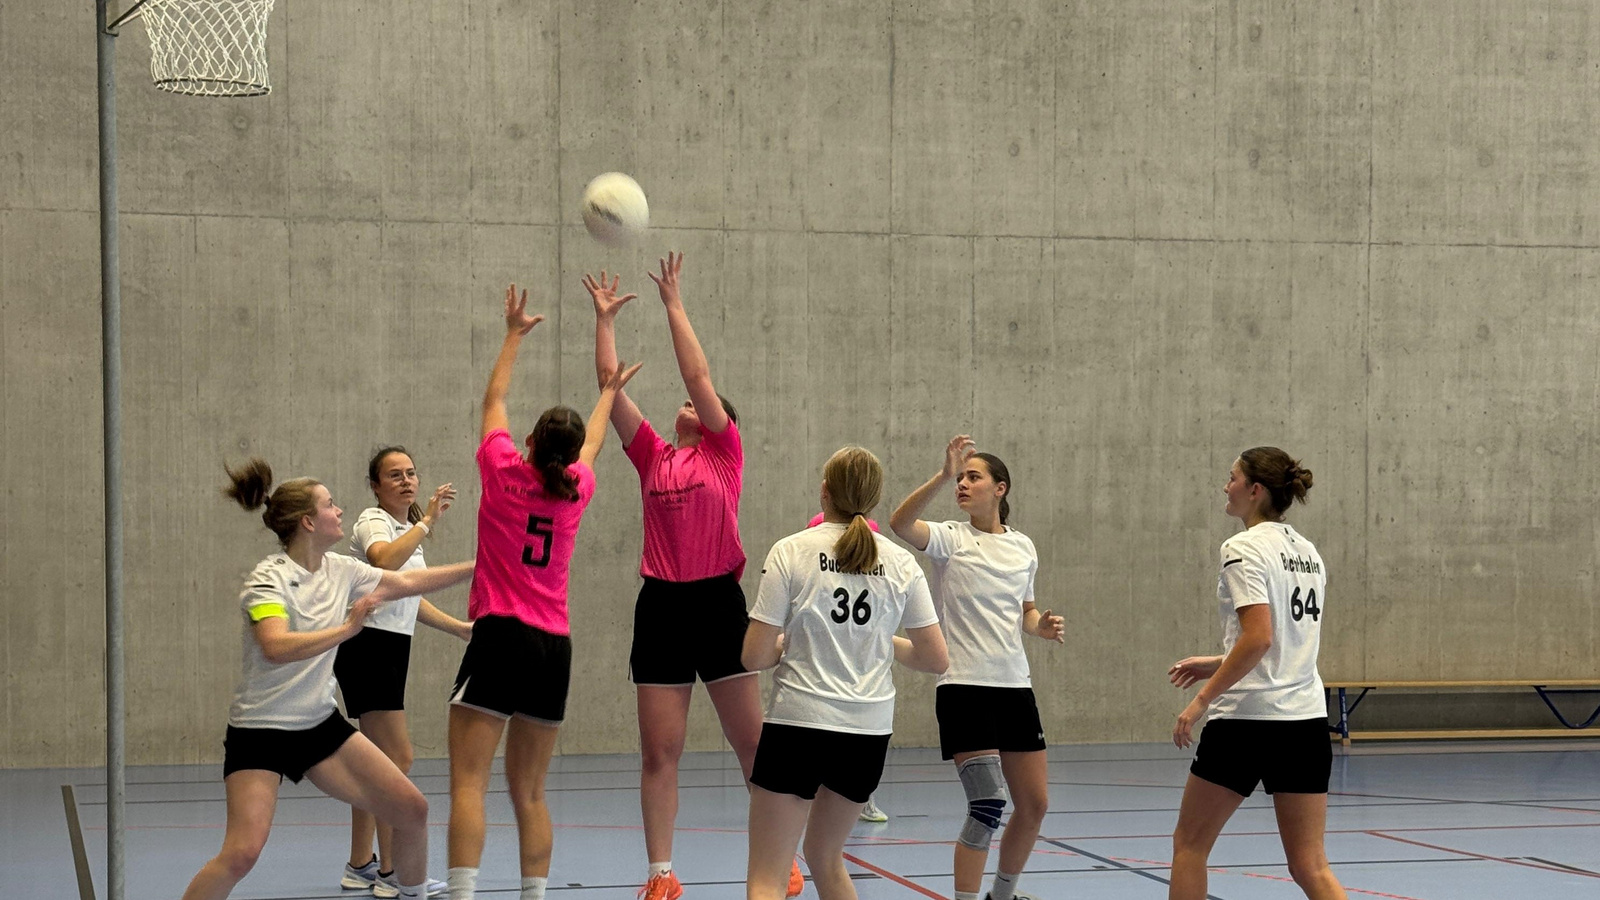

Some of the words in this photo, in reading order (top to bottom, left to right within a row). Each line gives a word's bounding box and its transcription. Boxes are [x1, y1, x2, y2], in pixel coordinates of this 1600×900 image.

[521, 514, 553, 568] 5
[831, 587, 871, 626] 36
[1291, 586, 1320, 622] 64
